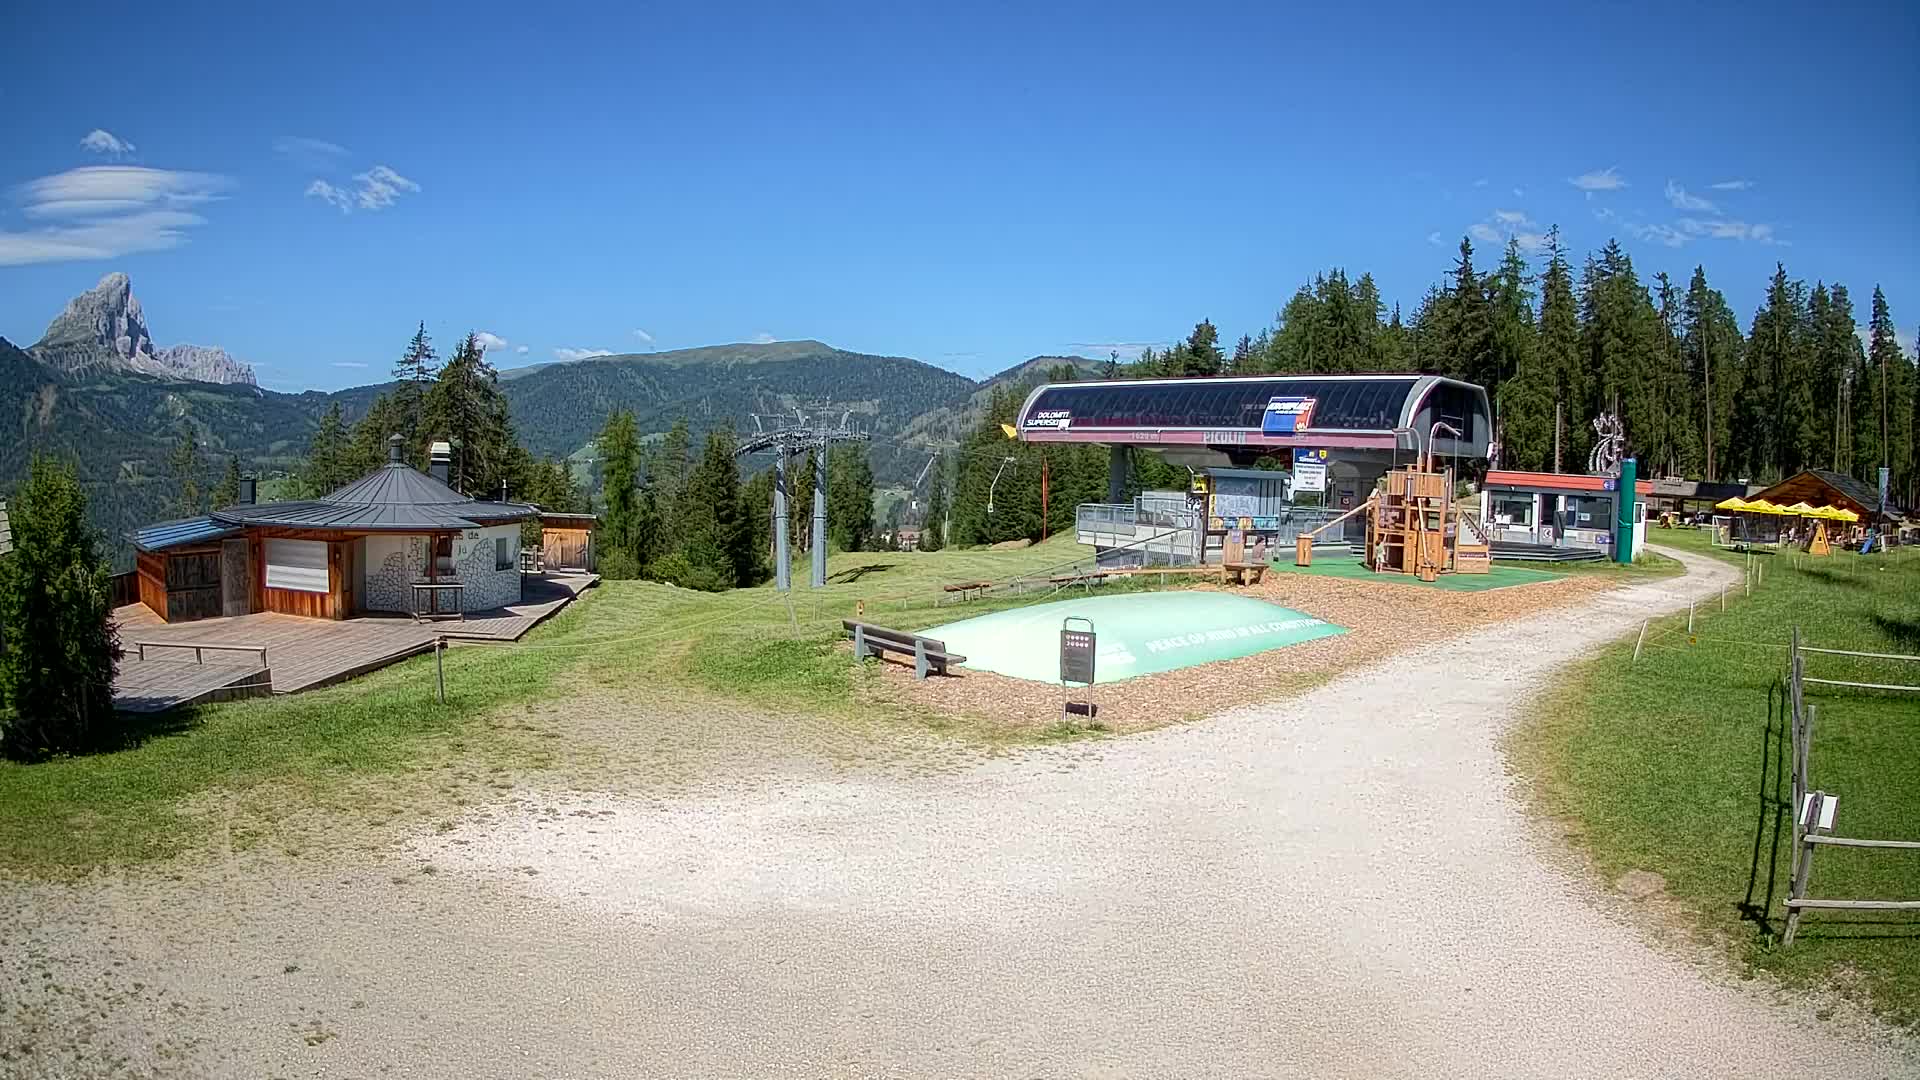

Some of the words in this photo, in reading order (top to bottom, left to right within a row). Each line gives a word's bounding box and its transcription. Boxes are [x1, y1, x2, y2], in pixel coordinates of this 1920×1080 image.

[1037, 411, 1070, 419] DOLOMITI
[1202, 431, 1248, 445] PICOLIN
[1147, 634, 1188, 653] PEACE
[1188, 632, 1206, 646] OF
[1250, 623, 1271, 636] ALL
